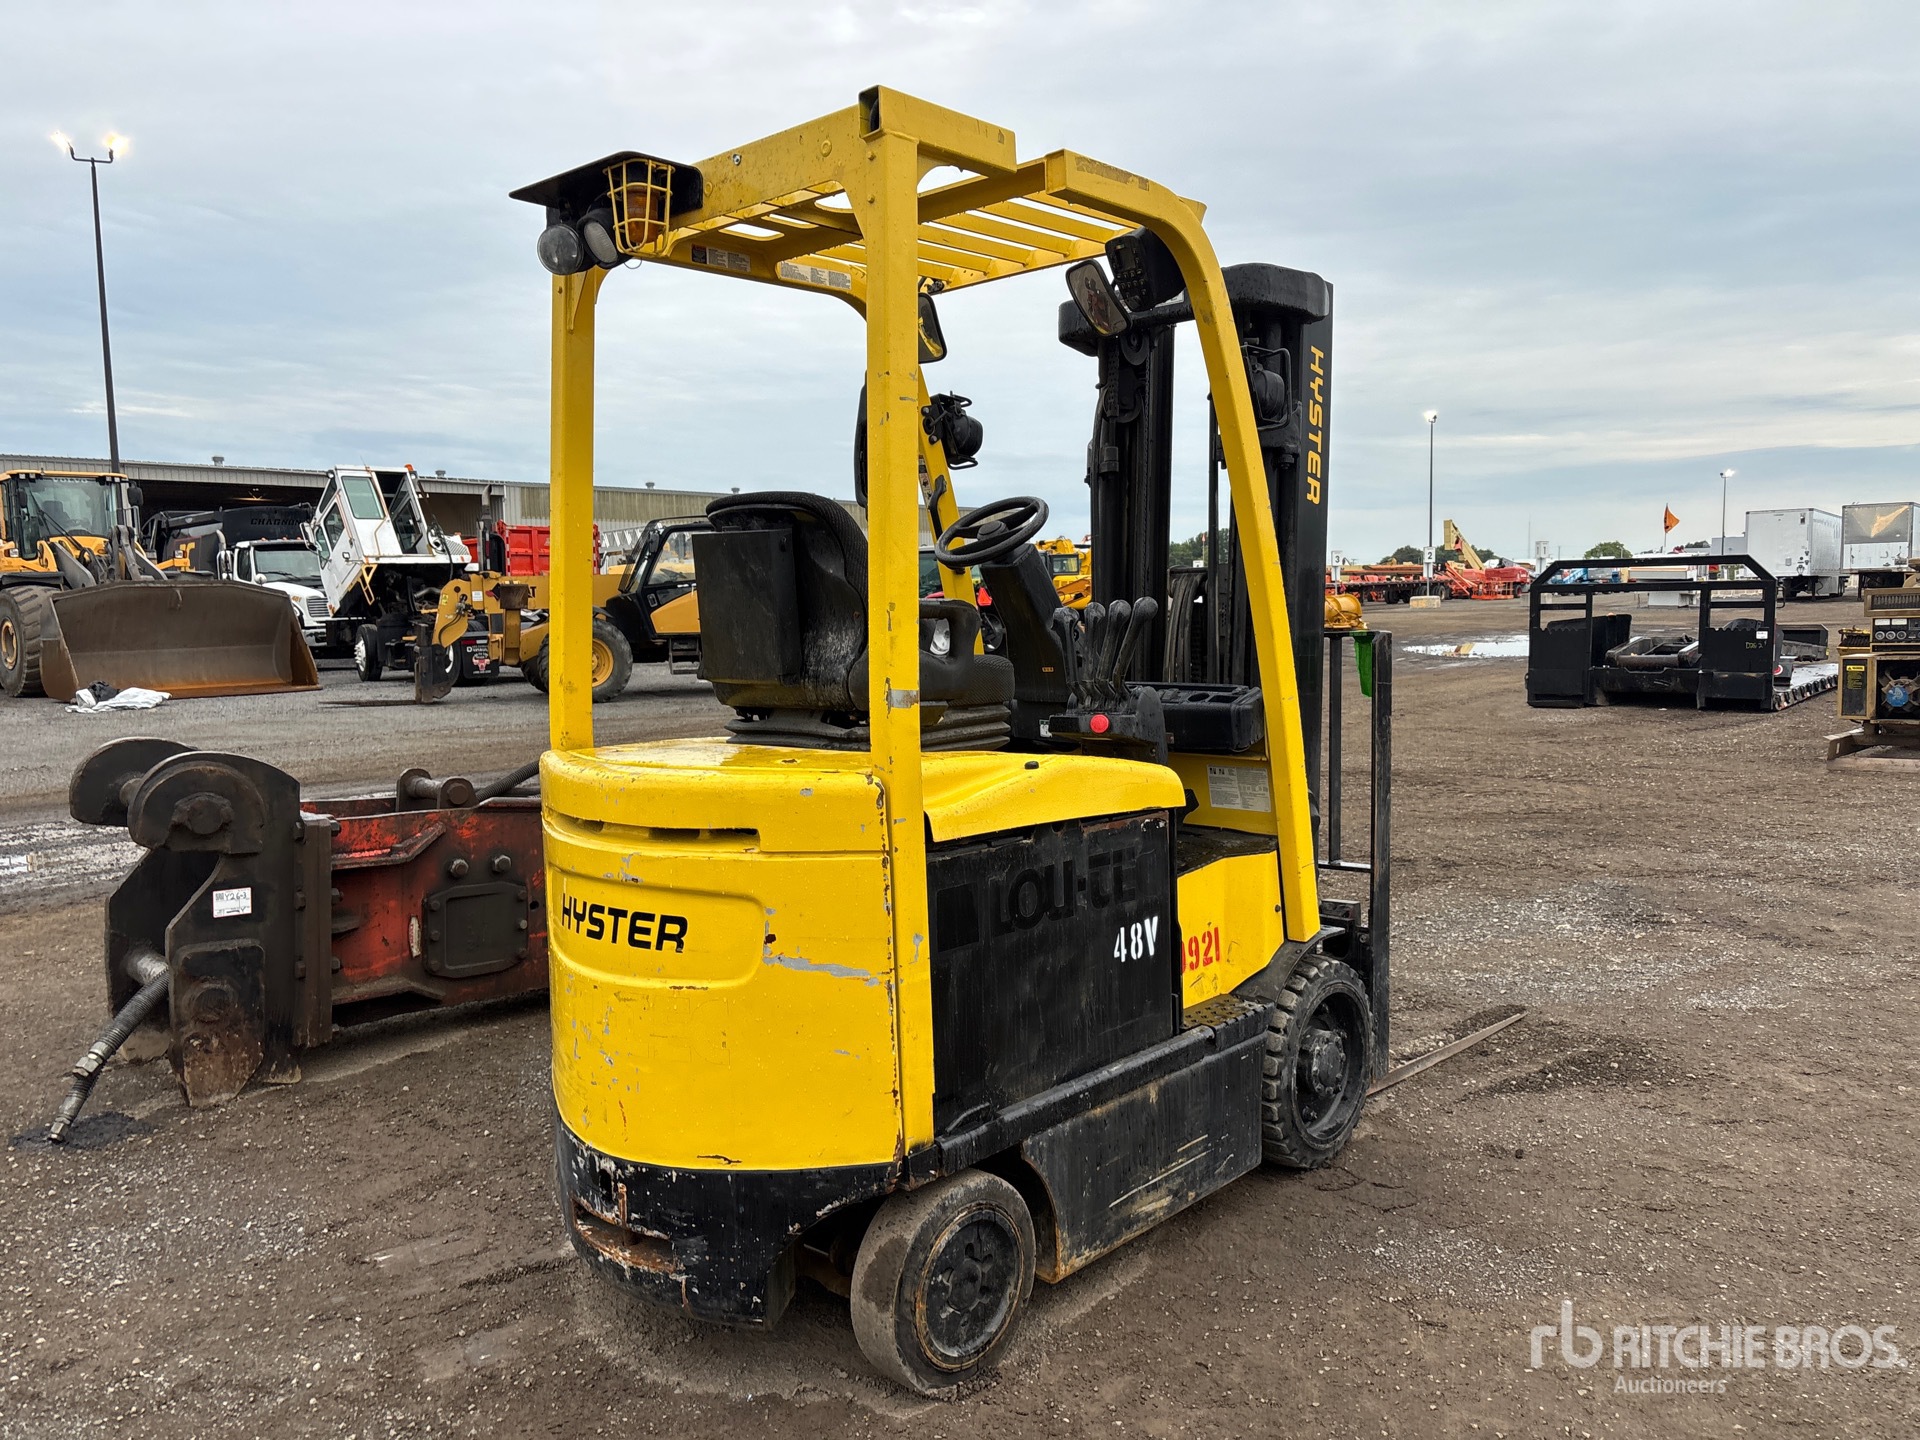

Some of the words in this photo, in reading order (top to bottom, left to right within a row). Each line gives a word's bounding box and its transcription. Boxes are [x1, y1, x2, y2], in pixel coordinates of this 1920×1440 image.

[1306, 345, 1325, 505] HYSTER
[1335, 555, 1340, 563] 3
[1427, 552, 1433, 560] 2
[562, 893, 688, 953] HYSTER
[1114, 916, 1158, 962] 48V
